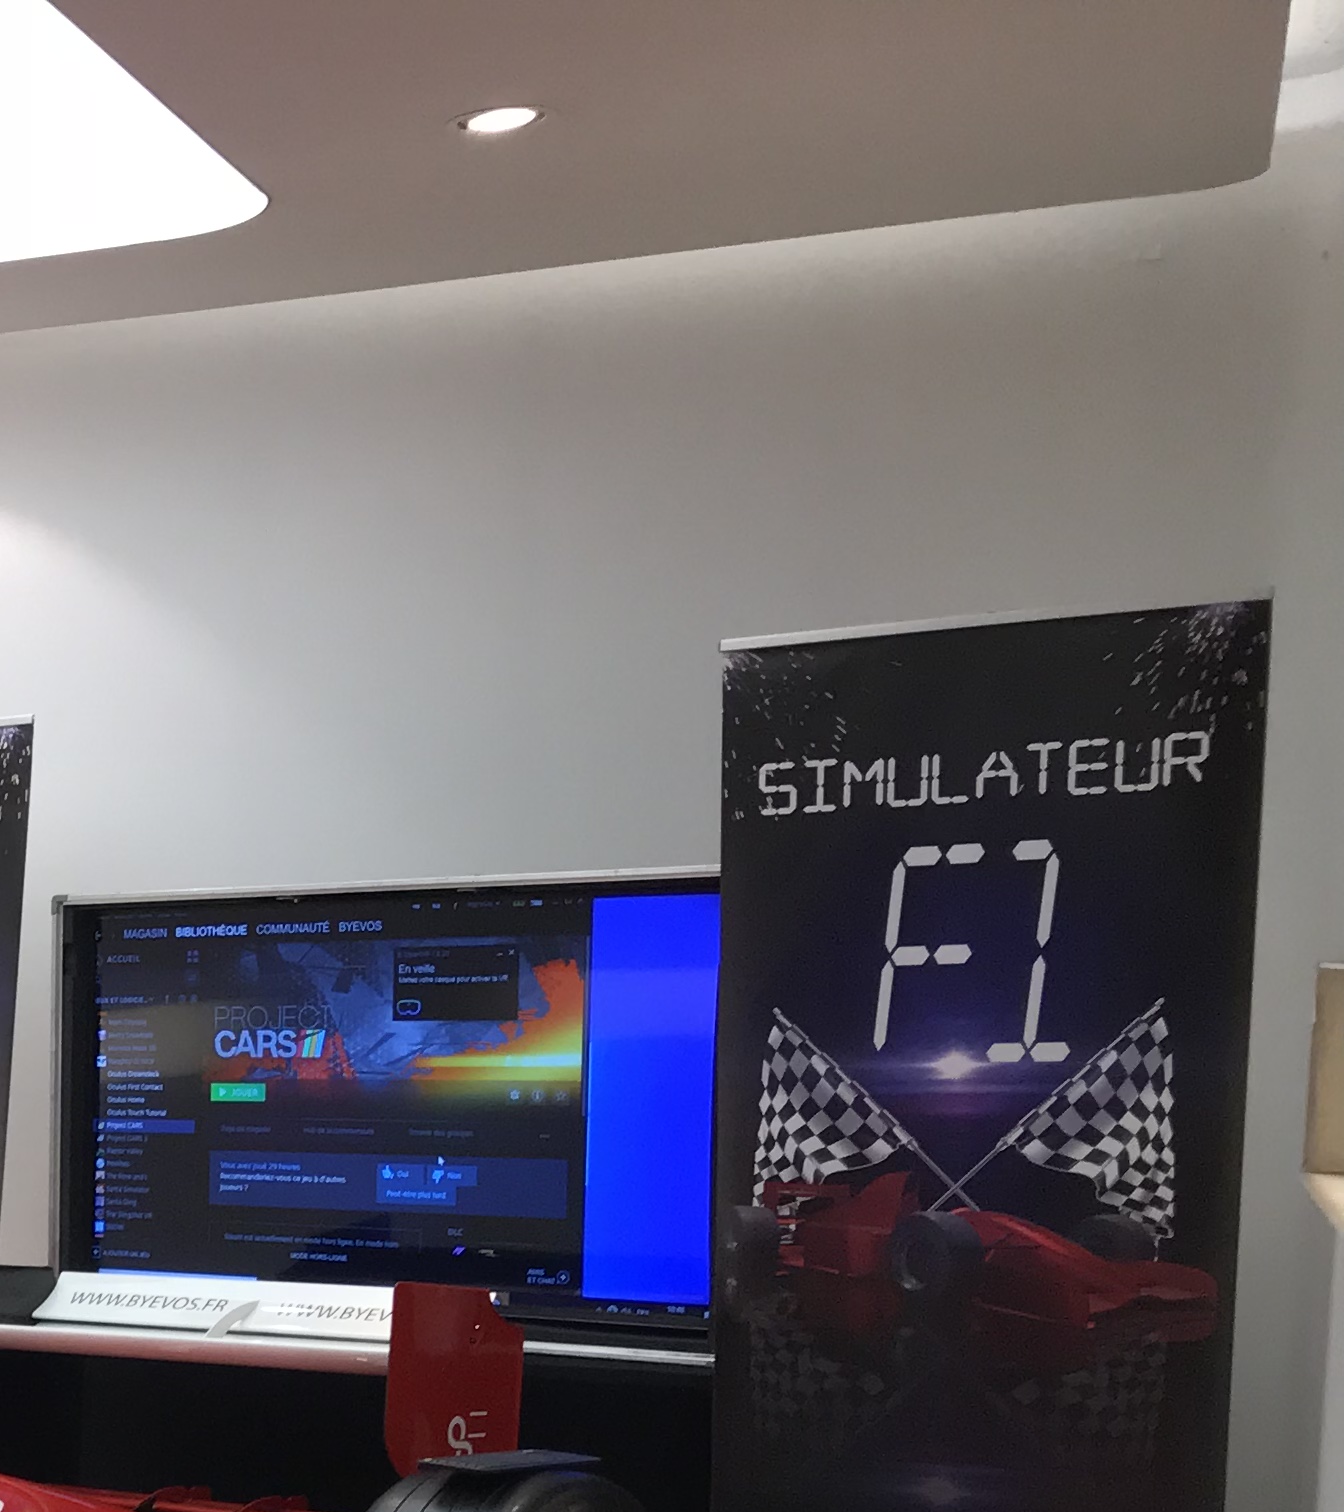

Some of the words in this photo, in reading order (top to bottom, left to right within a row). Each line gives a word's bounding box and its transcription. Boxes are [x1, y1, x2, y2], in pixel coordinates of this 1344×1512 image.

[758, 731, 1211, 817] SIMULATEUR
[123, 928, 168, 939] MAGASIN
[174, 923, 248, 938] BIBLIOTHÈQUE
[255, 920, 330, 935] COMMUNAUTÉ
[338, 920, 383, 933] BYEVOS
[873, 838, 1071, 1063] F1
[398, 963, 412, 974] En
[214, 1005, 331, 1030] PROJECT
[214, 1029, 297, 1059] CARS
[71, 1291, 230, 1312] WWW.BYEVOS.FR
